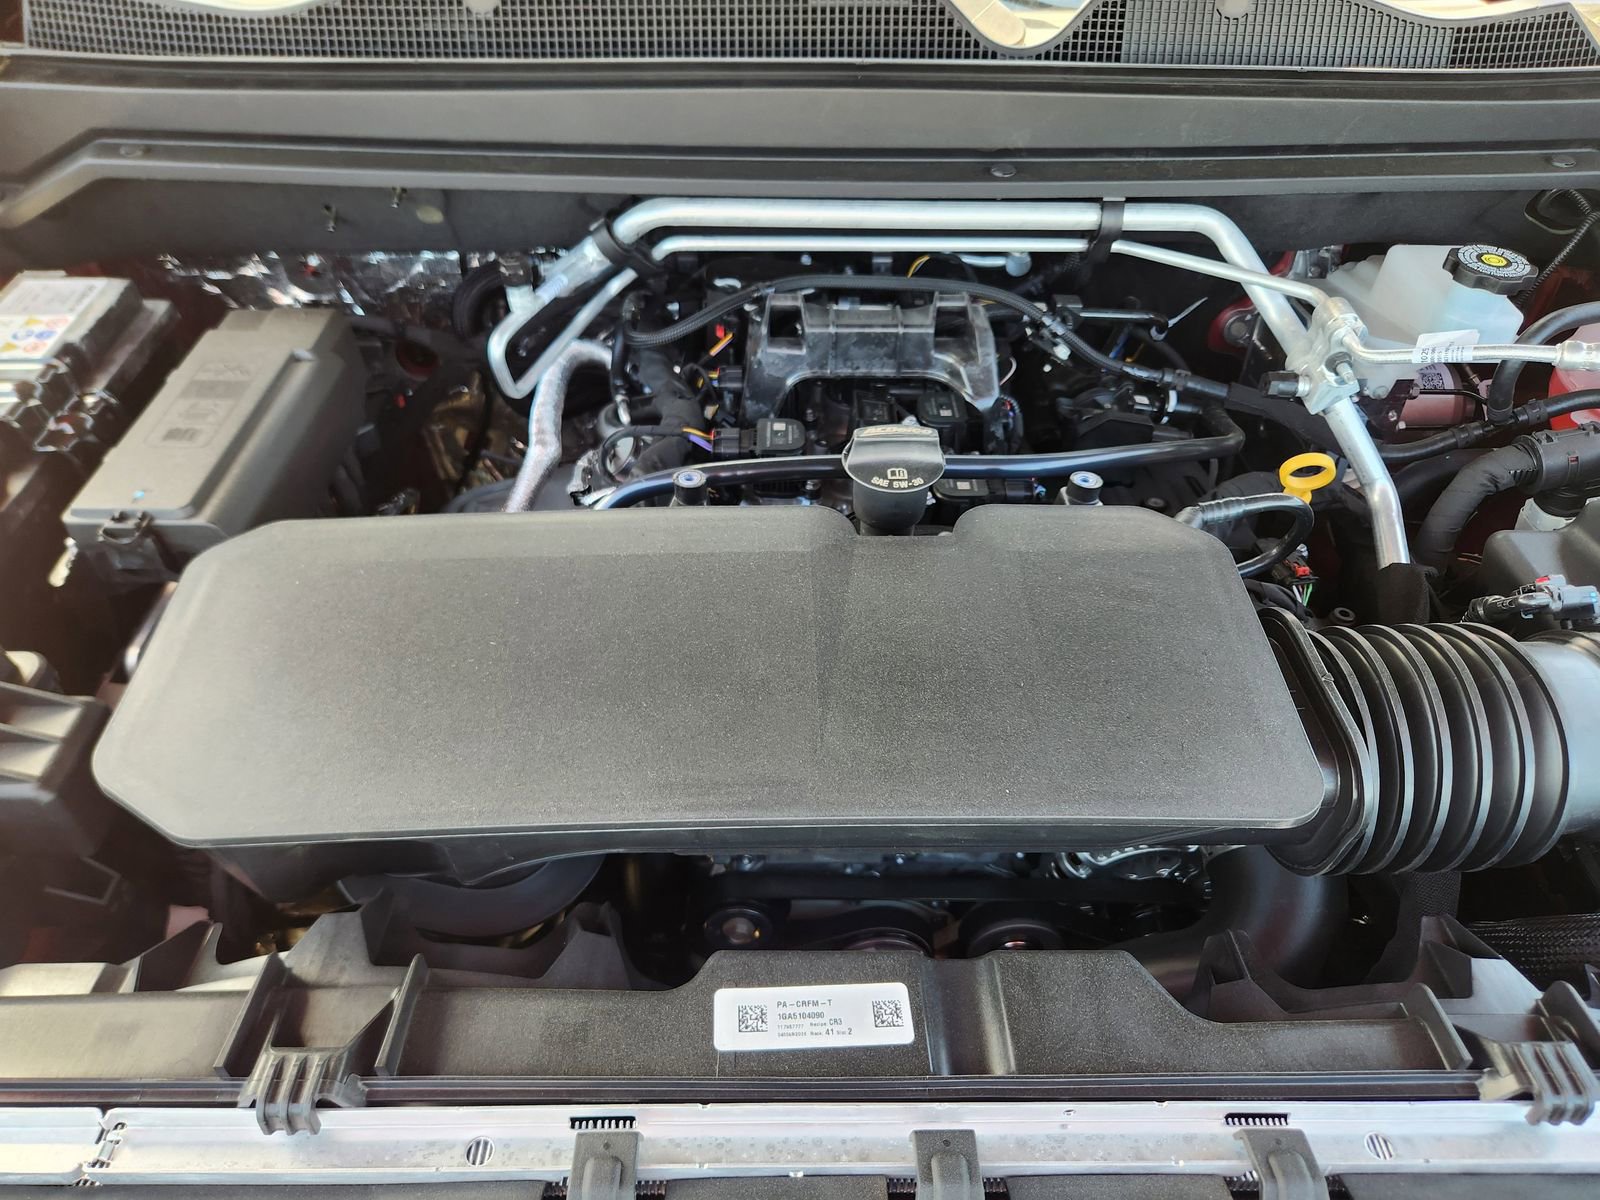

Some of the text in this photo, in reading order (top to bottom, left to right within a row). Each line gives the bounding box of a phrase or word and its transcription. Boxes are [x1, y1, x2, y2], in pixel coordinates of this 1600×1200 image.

[871, 476, 924, 488] SAE 5W-30
[828, 1018, 843, 1026] CR3
[825, 1028, 834, 1036] 41
[847, 1027, 853, 1036] 2
